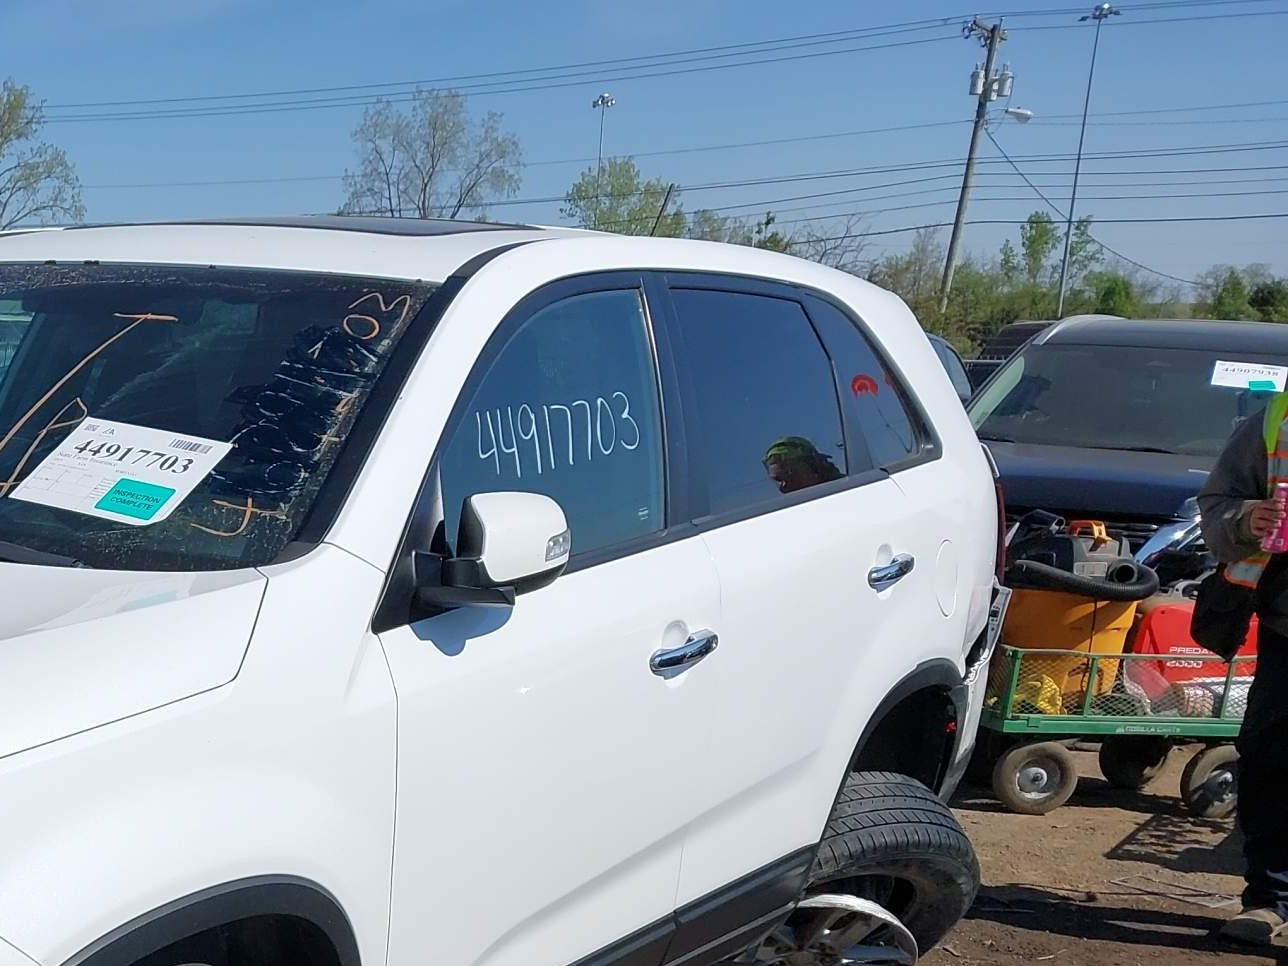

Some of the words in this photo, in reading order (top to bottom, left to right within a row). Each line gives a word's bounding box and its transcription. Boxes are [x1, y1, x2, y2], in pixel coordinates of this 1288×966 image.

[475, 391, 640, 478] 44917703
[73, 439, 194, 474] 44917703
[113, 489, 161, 503] INSPECTION
[111, 497, 153, 510] COMPLETE
[1168, 646, 1215, 655] PREDA
